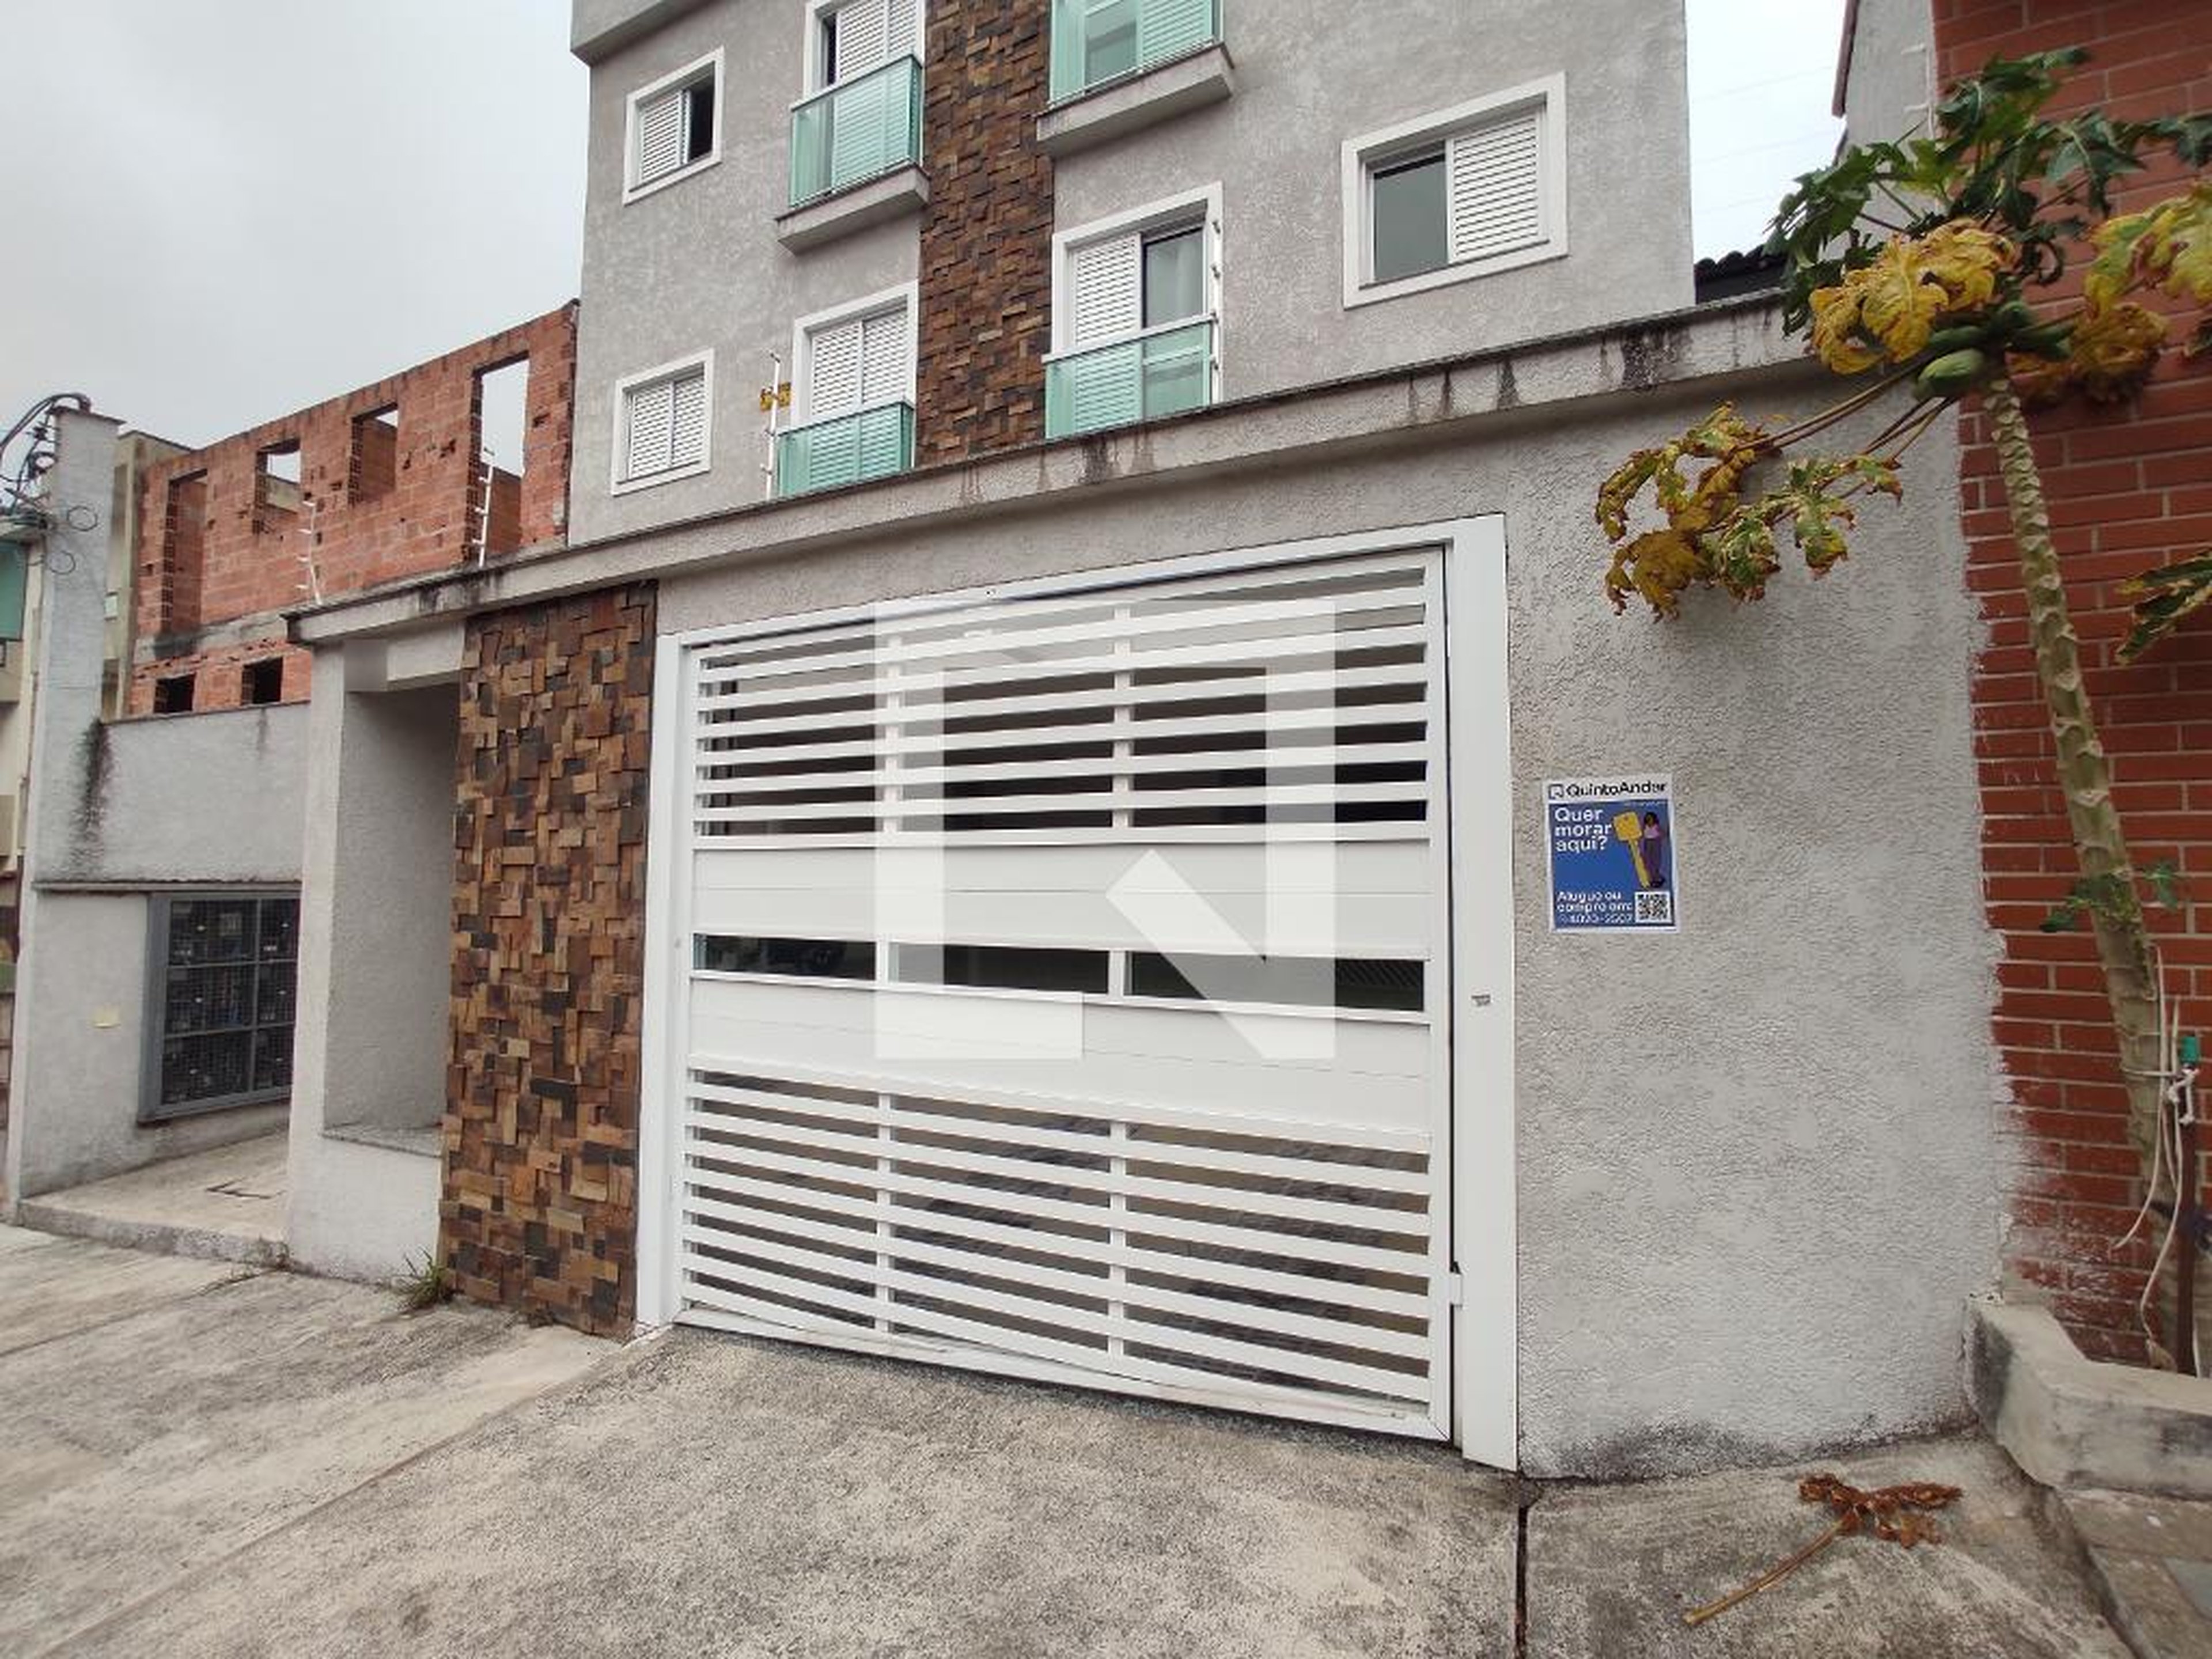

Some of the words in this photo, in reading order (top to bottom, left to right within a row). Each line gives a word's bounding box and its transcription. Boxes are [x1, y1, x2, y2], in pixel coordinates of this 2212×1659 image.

[1566, 781, 1666, 797] QuintoAndar
[1555, 808, 1603, 822] Quer
[1555, 824, 1612, 837] morar
[1556, 837, 1608, 853] aqui?
